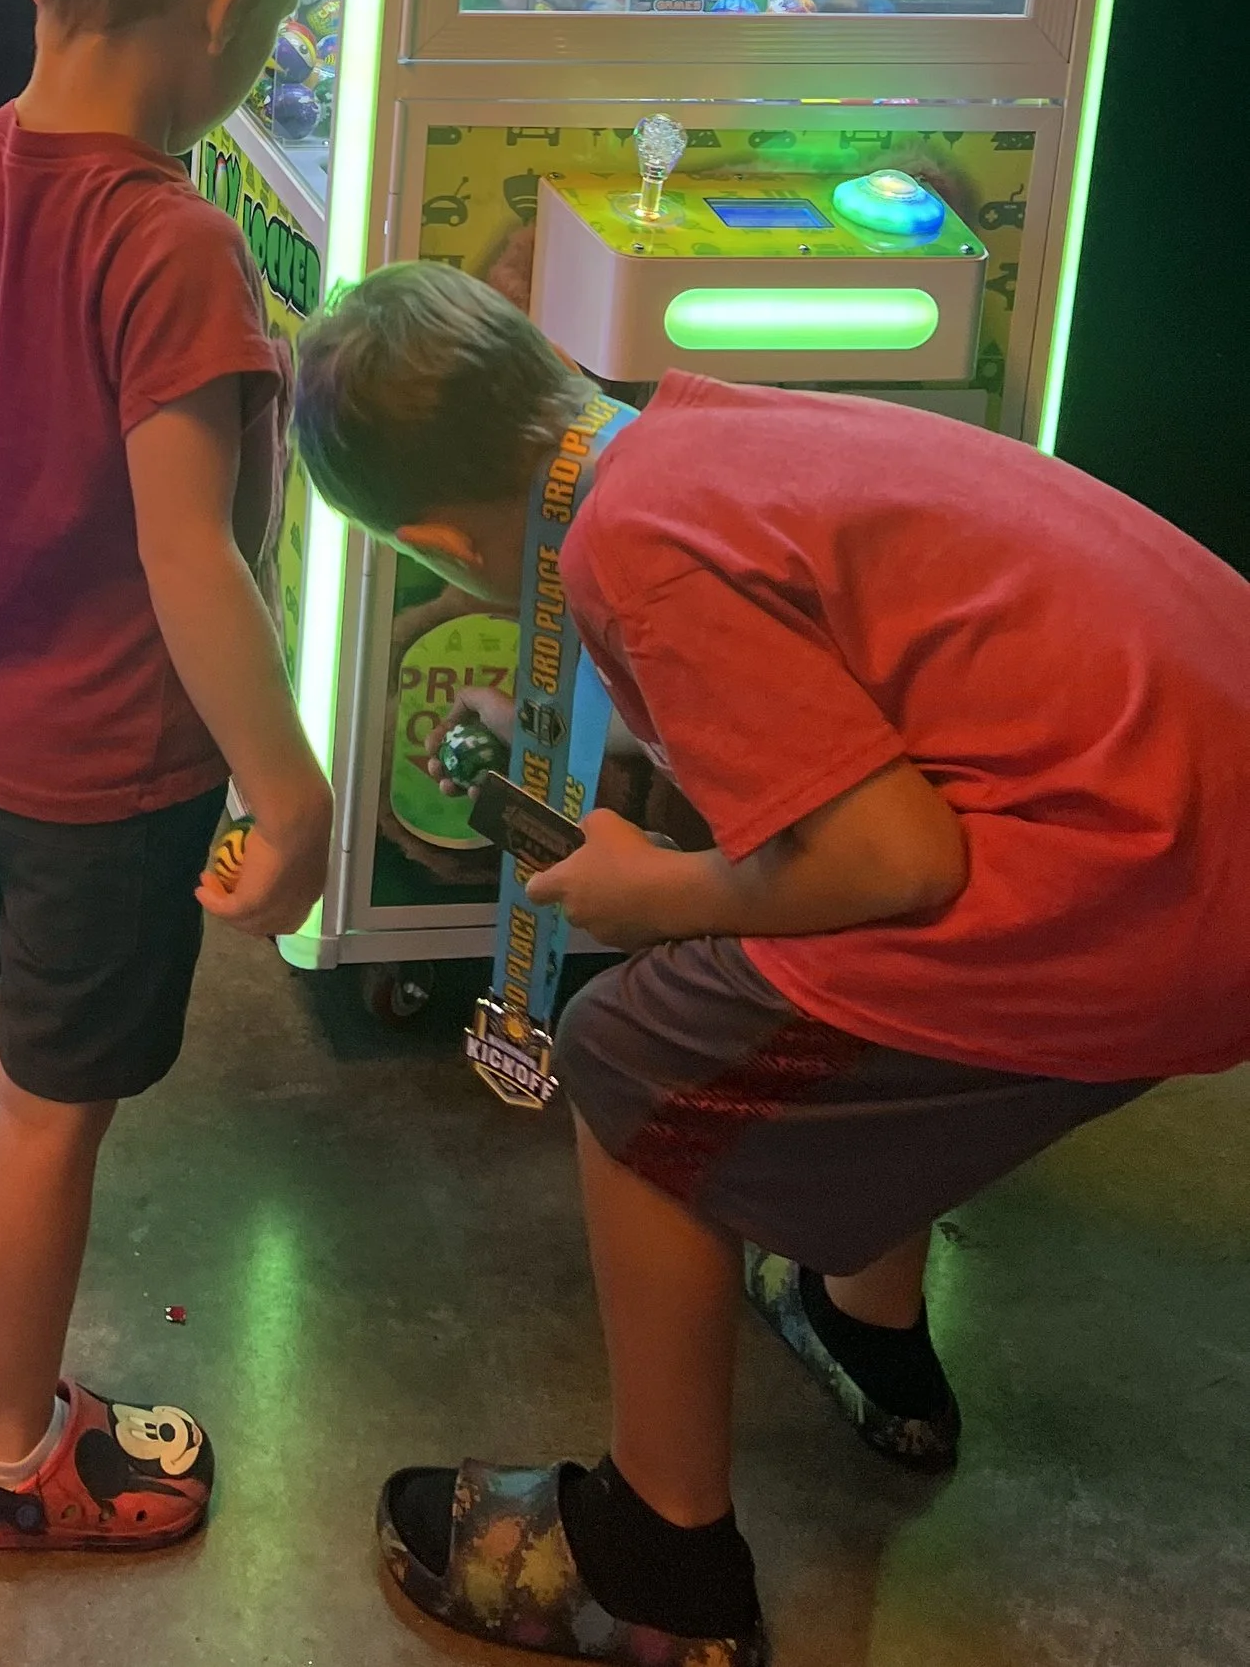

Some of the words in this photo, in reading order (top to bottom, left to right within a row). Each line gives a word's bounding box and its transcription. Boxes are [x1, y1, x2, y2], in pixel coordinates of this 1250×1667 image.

[541, 457, 582, 523] 3RD
[534, 542, 566, 633] PLACE
[400, 666, 516, 704] PRIZ
[531, 635, 562, 695] 3RD
[523, 750, 550, 804] ACE
[506, 903, 537, 984] PLACE
[465, 1035, 554, 1102] KICKOFF
